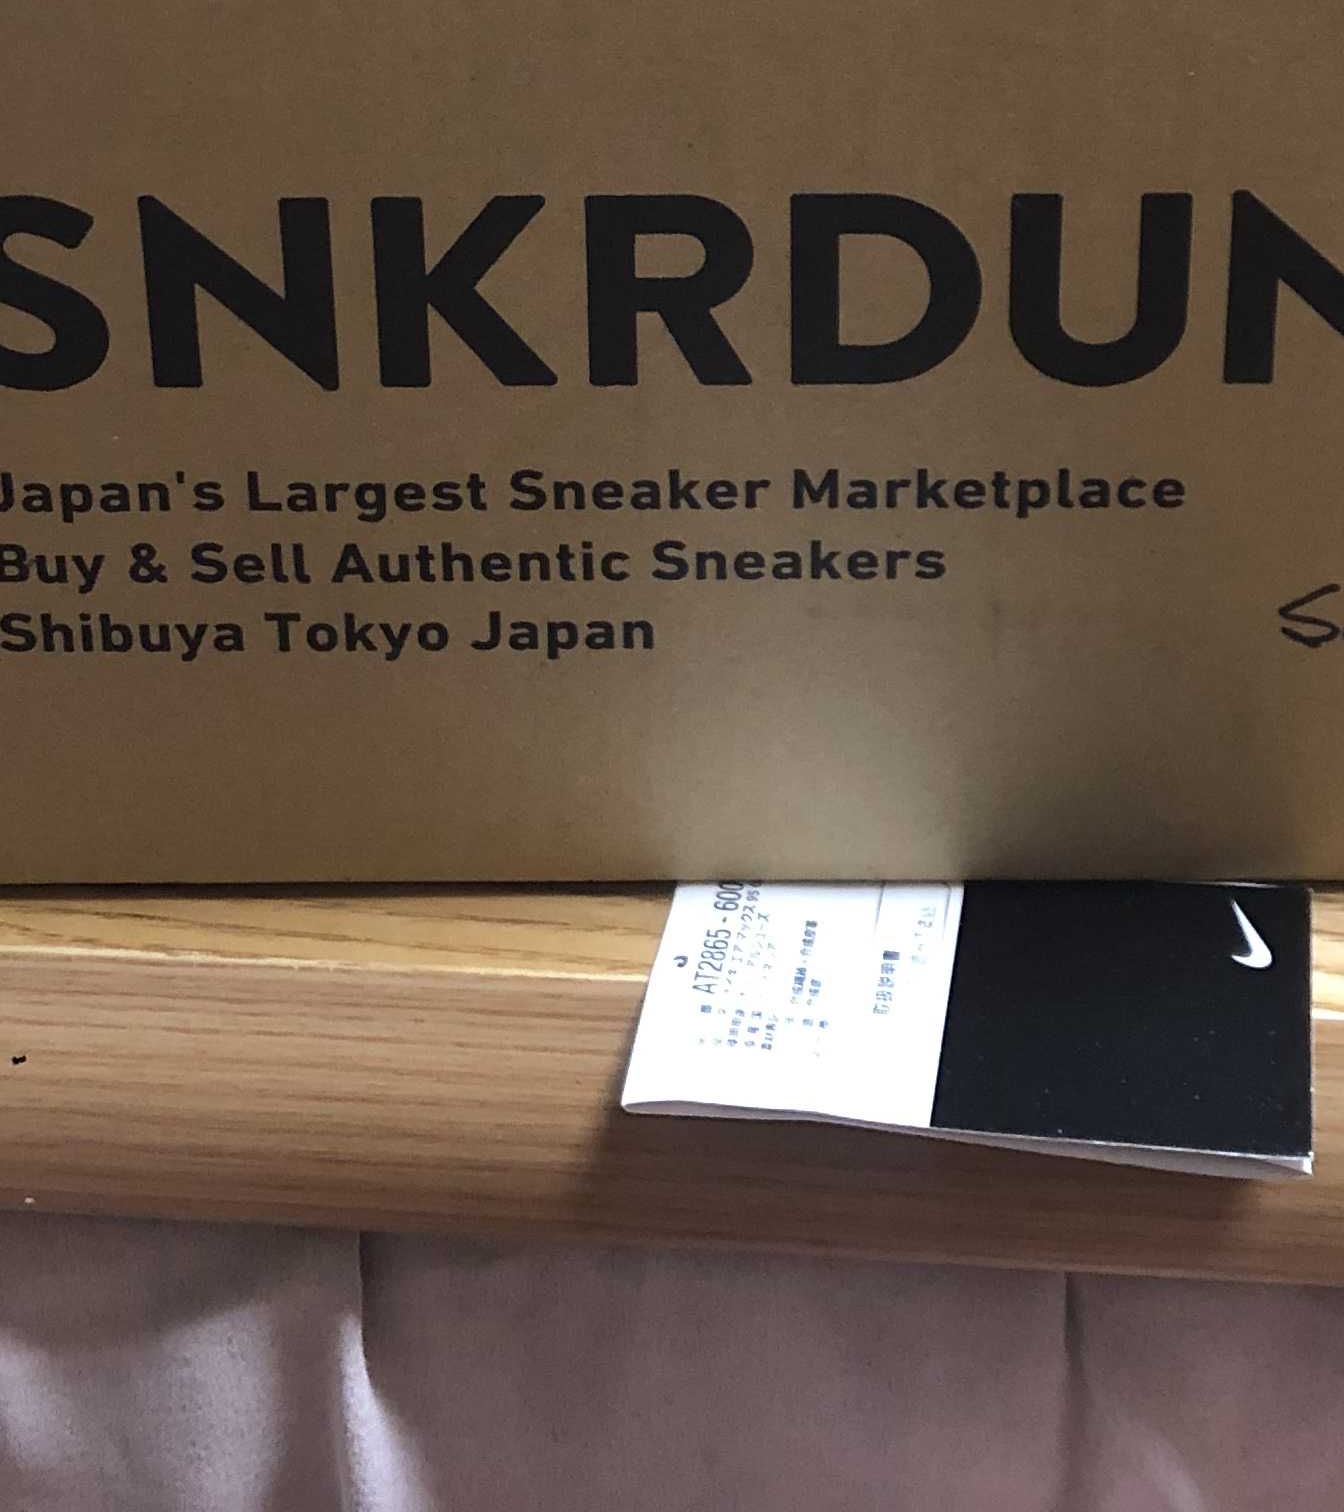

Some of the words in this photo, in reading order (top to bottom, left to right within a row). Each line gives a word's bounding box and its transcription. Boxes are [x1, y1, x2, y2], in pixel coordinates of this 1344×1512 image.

[247, 471, 488, 523] Largest
[510, 469, 772, 511] Sneaker
[792, 468, 1185, 520] Marketplace
[128, 543, 168, 584] &
[191, 543, 312, 584] Sell
[331, 541, 631, 583] Authentic
[652, 540, 946, 581] Sneakers
[0, 612, 245, 662] Shibuya
[264, 612, 450, 662] Tokyo
[471, 611, 655, 661] Japan
